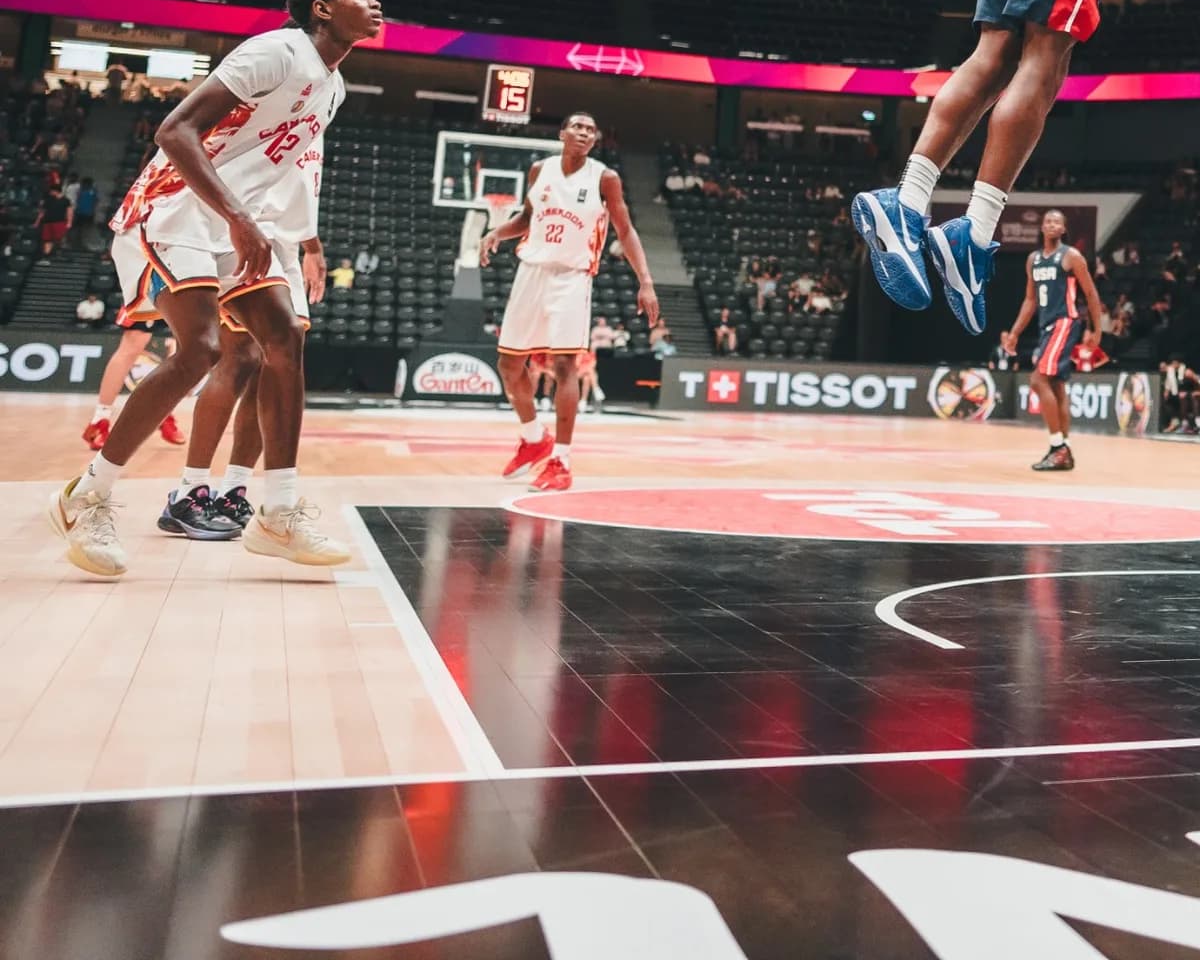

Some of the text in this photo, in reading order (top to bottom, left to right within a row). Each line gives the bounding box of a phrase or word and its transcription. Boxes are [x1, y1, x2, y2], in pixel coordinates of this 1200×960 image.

[499, 86, 526, 112] 15
[264, 131, 301, 166] 12
[545, 223, 565, 244] 22
[1032, 266, 1058, 282] USA
[0, 342, 102, 383] OT
[678, 370, 917, 410] T TISSOT
